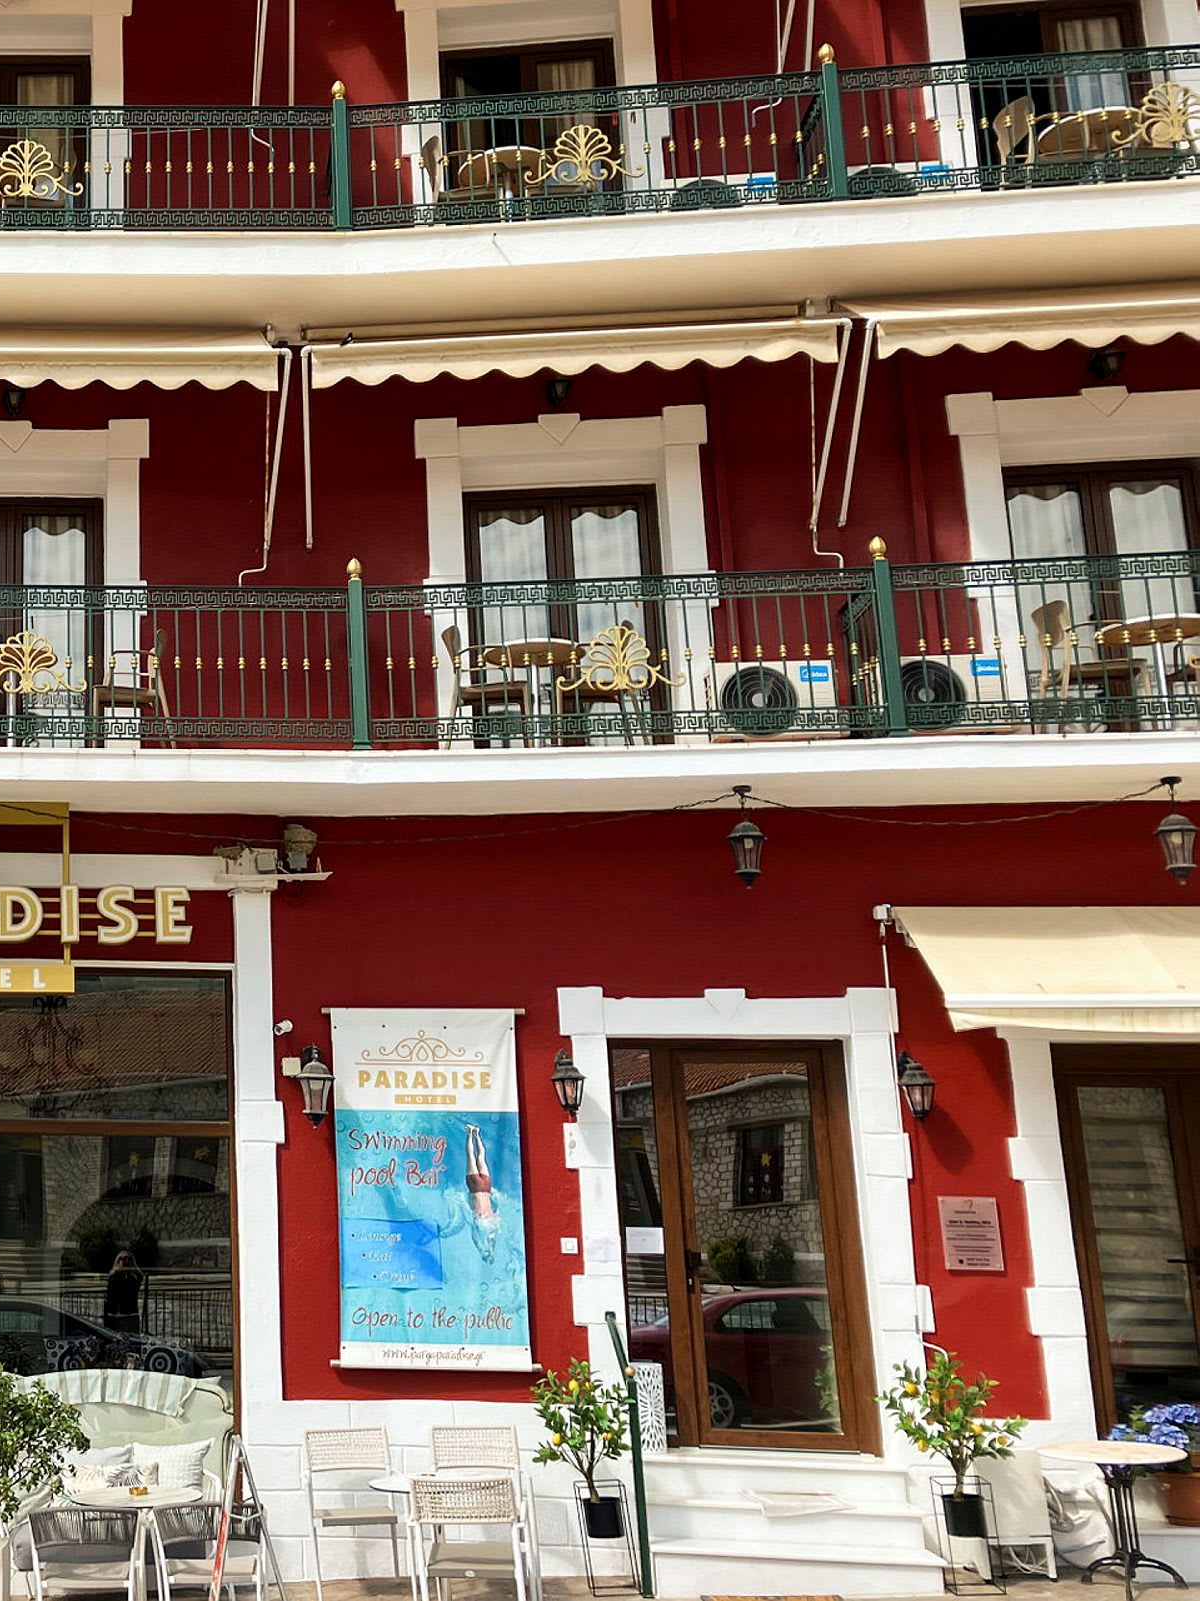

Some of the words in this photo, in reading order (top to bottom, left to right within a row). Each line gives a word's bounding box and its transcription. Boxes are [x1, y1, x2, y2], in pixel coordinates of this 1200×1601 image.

[358, 1069, 491, 1089] PARADISE
[404, 1095, 452, 1104] HOTEL
[348, 1128, 447, 1164] Swimming
[350, 1158, 397, 1197] pool
[406, 1160, 447, 1187] Bar
[352, 1307, 399, 1337] Open
[407, 1306, 424, 1328] to
[432, 1306, 457, 1328] the
[464, 1306, 513, 1340] public
